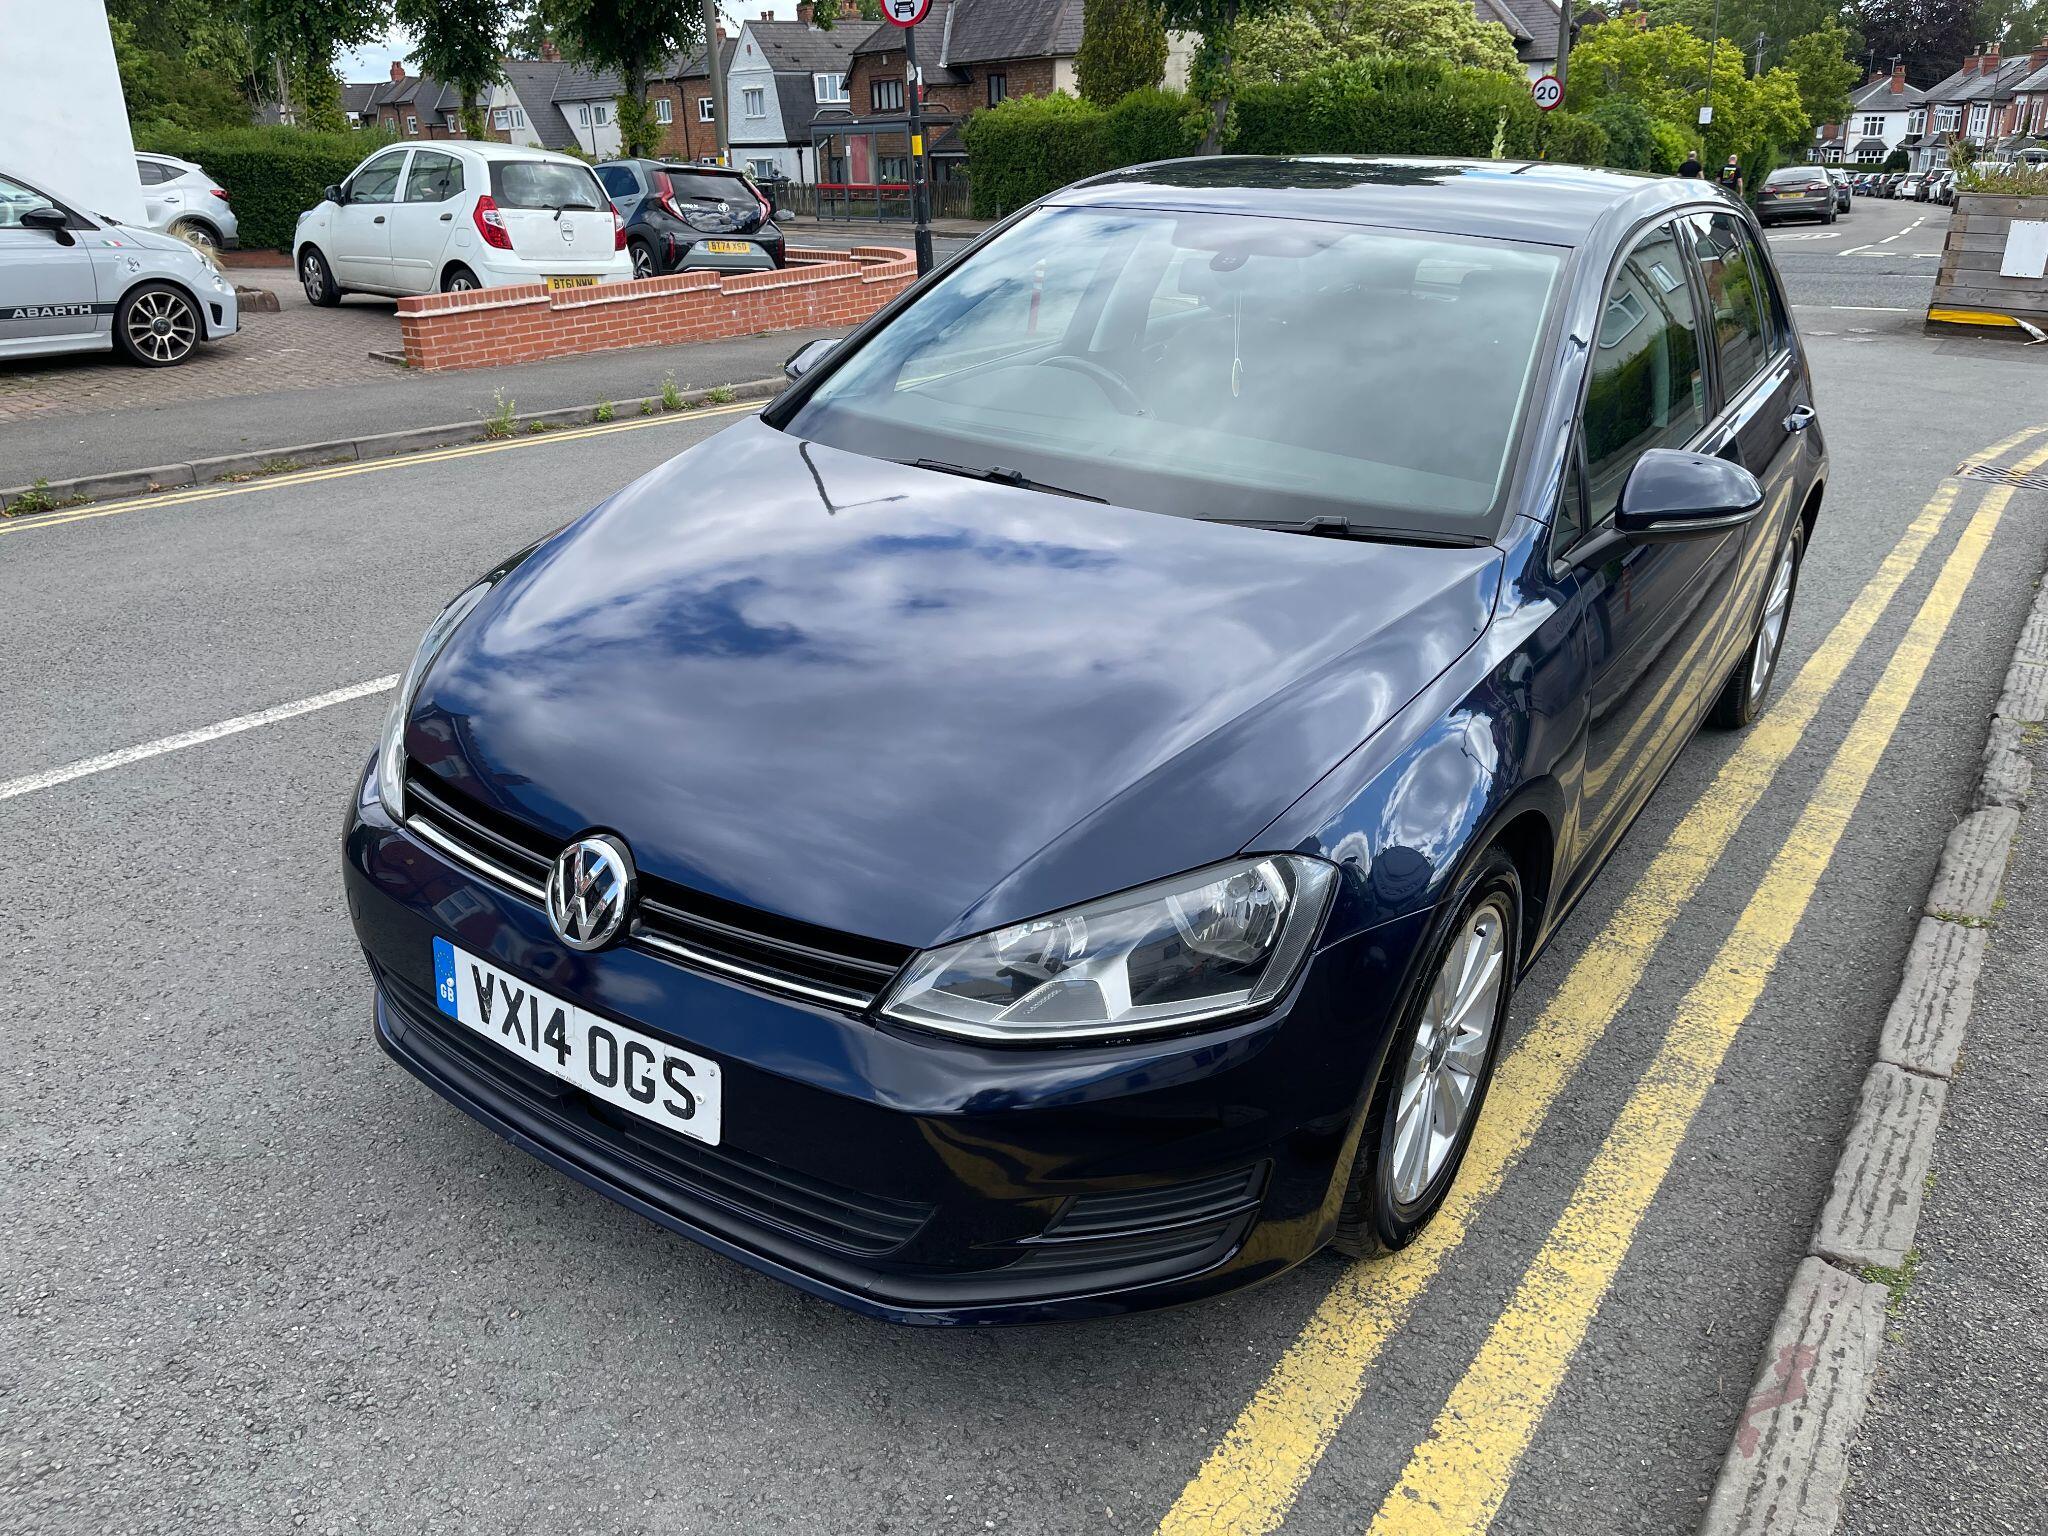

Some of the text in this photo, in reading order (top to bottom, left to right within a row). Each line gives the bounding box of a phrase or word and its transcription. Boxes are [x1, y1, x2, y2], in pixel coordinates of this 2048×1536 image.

[1536, 86, 1559, 100] 20
[553, 278, 574, 289] BT61
[12, 304, 92, 319] ABARTH
[440, 983, 455, 1003] GB
[471, 963, 696, 1121] VX14 OGS
